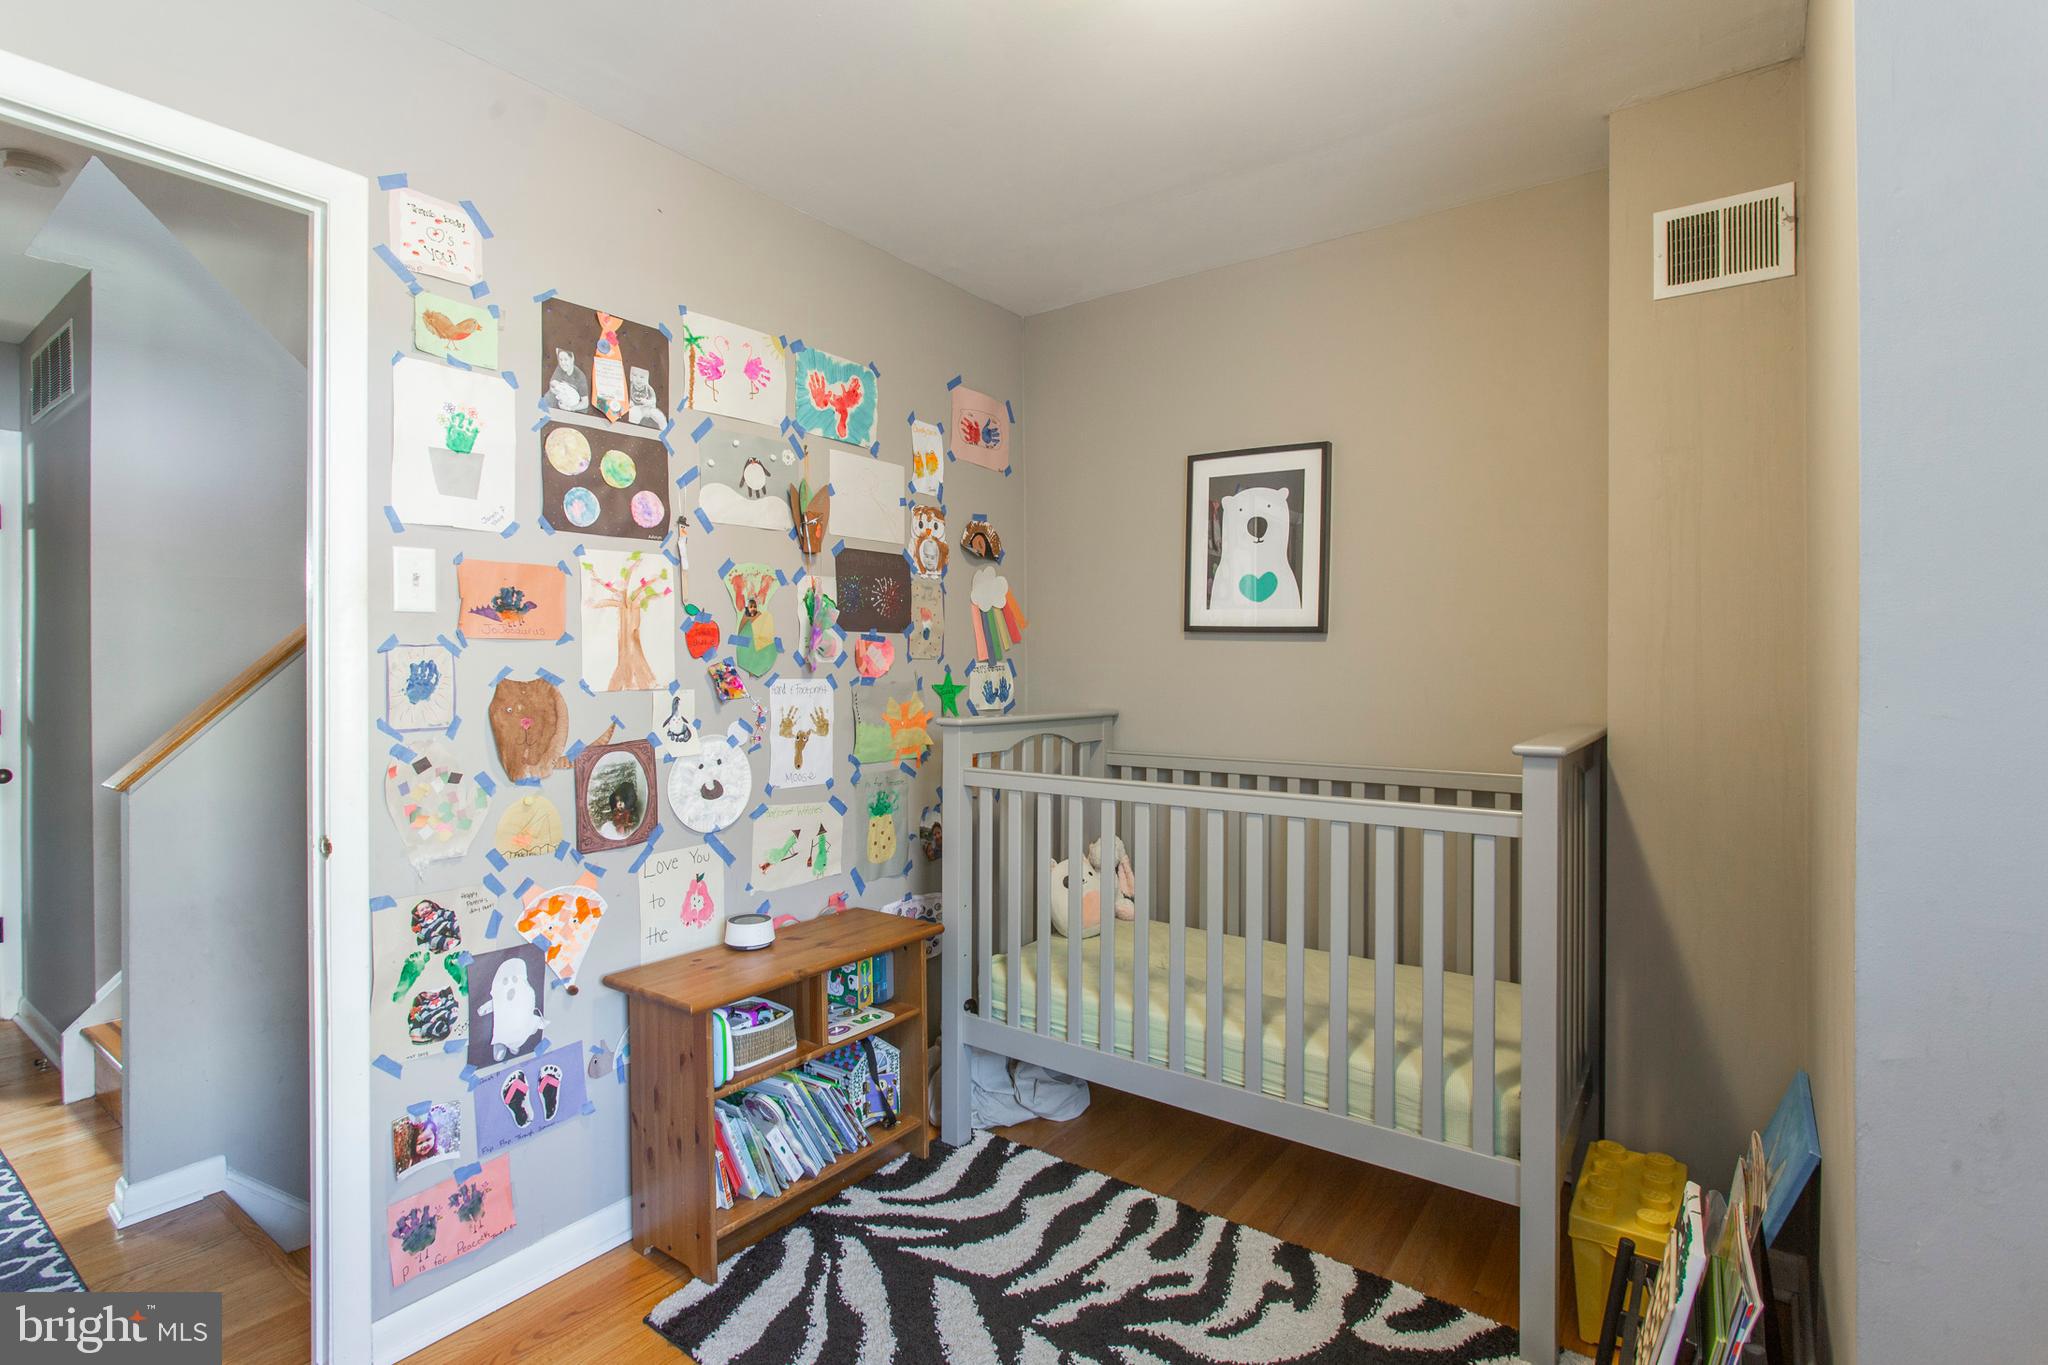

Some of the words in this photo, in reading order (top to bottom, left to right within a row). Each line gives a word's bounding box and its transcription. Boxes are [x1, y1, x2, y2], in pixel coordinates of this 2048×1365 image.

[643, 857, 679, 879] Love
[689, 847, 711, 864] You
[648, 893, 666, 909] to
[645, 926, 668, 945] the
[402, 1265, 410, 1283] P
[418, 1263, 426, 1273] is
[433, 1254, 447, 1267] for
